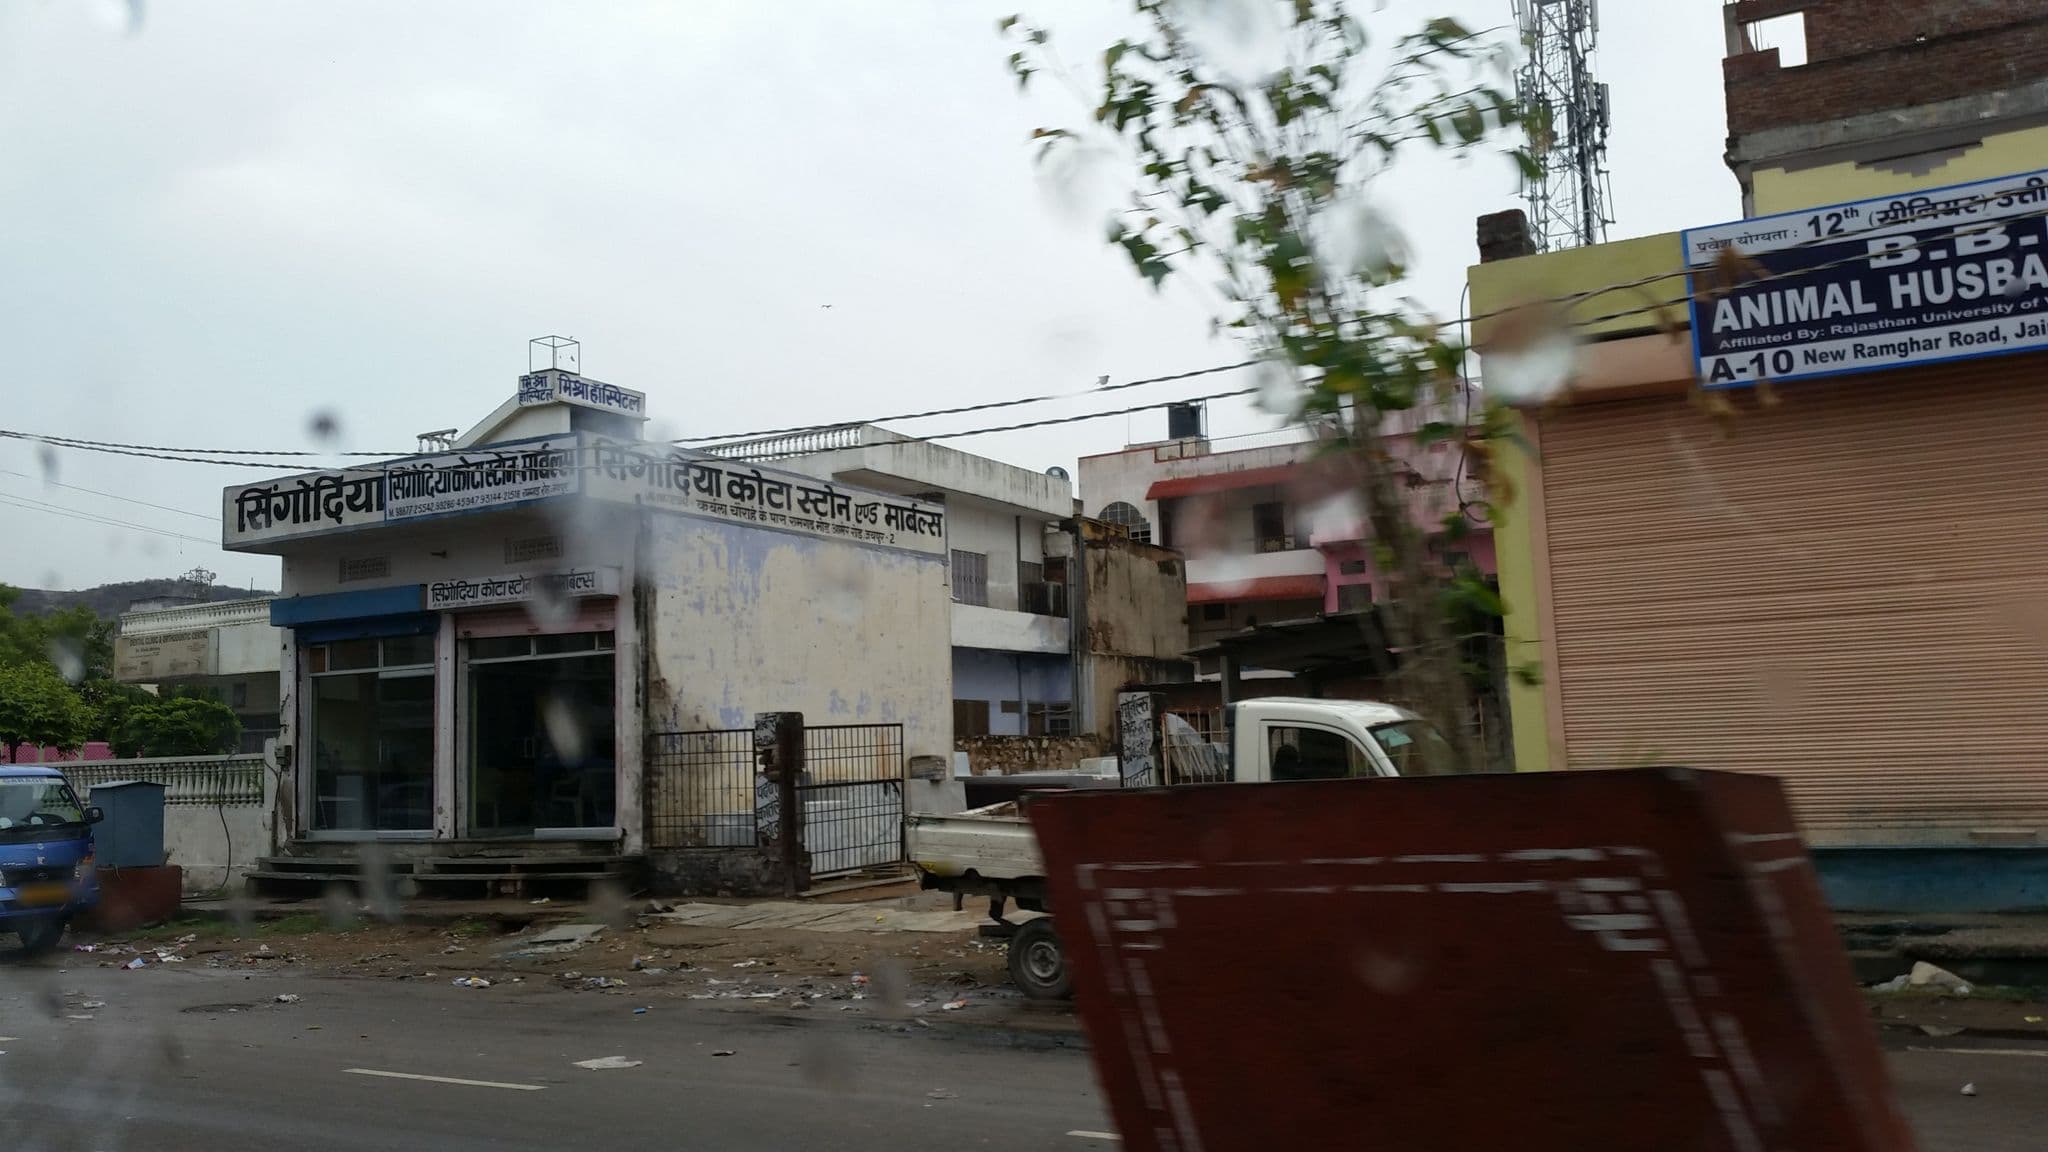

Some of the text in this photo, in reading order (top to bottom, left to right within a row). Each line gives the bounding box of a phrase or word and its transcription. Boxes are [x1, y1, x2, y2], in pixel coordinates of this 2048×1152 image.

[1736, 229, 1789, 246] योग्यता
[1712, 279, 1878, 334] ANIMAL
[1719, 297, 2040, 350] Affiliated By: Rajasthan University of
[1709, 319, 2048, 383] A-10 New Ramghar Road, Jai
[727, 469, 793, 511] कोटा
[795, 484, 852, 522] स्टोन
[883, 499, 944, 539] मार्बल्स
[481, 578, 508, 598] कोटा
